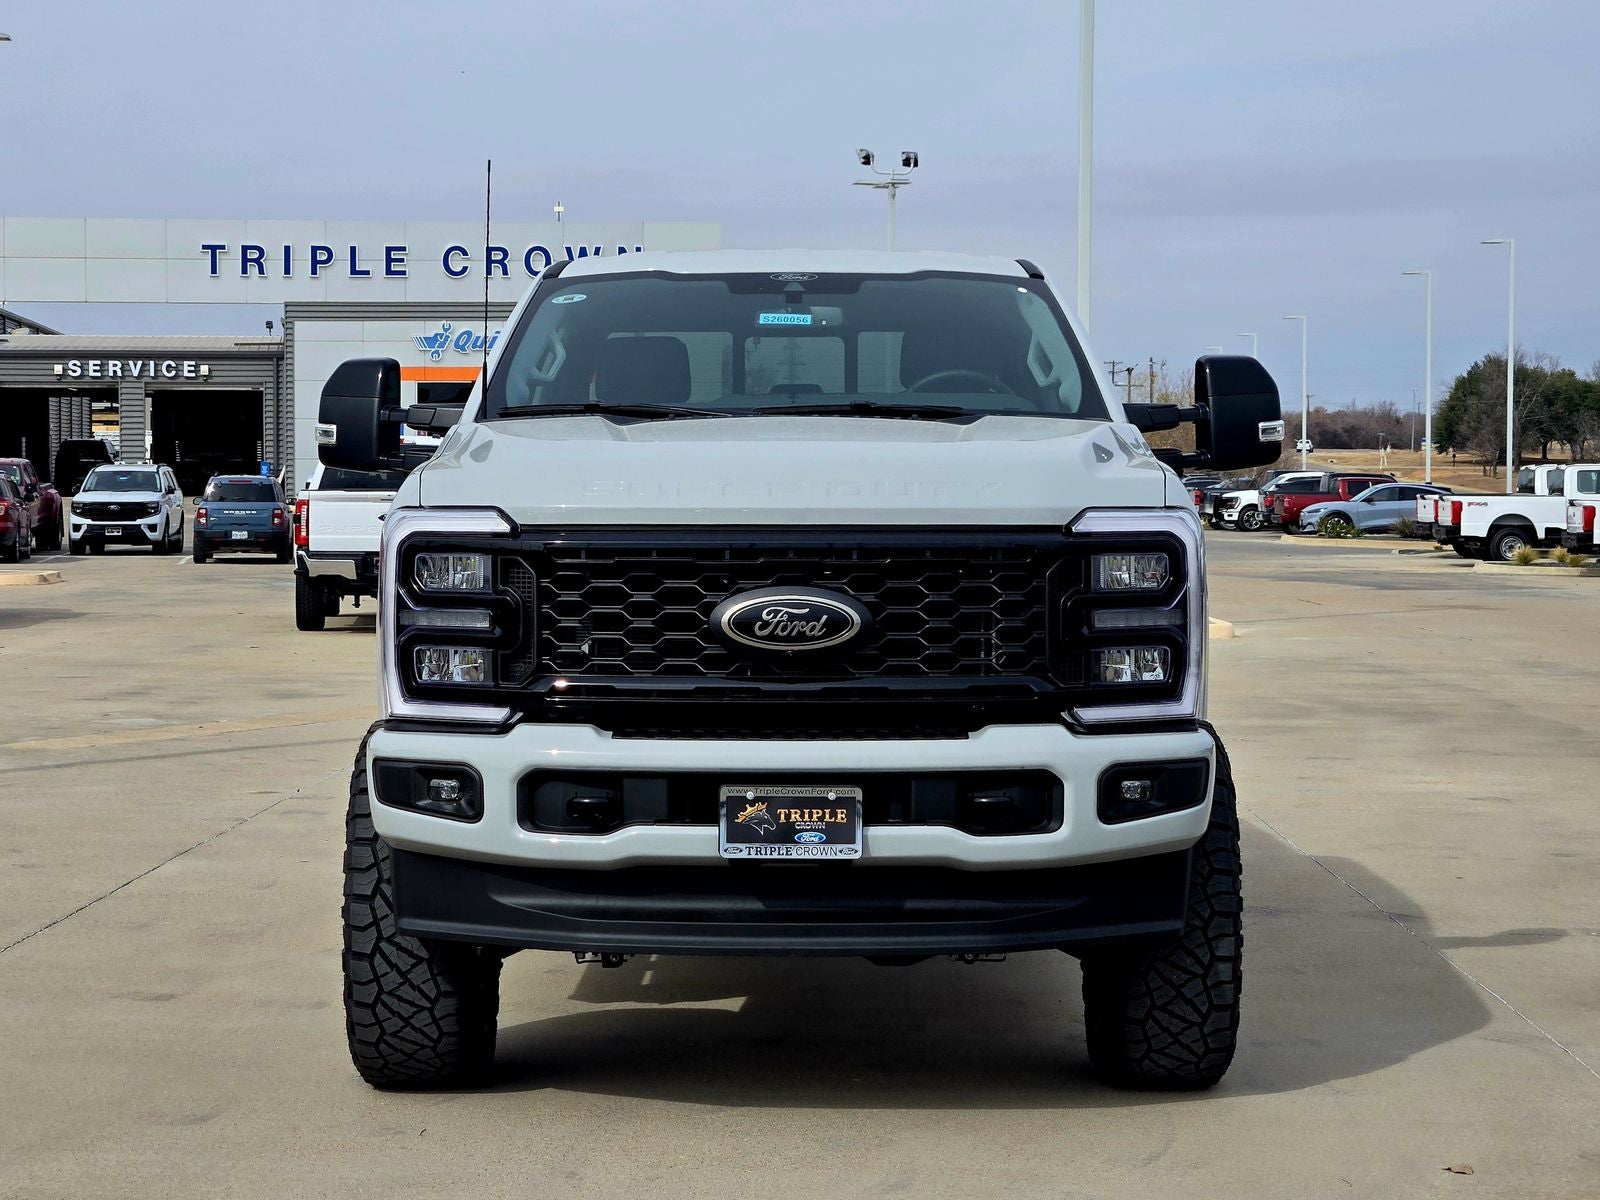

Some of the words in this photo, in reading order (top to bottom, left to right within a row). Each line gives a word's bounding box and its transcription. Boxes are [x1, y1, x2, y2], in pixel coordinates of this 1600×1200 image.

[201, 243, 409, 278] TRIPLE
[442, 243, 643, 279] CRO
[762, 315, 809, 323] S260056
[453, 329, 501, 353] Qui
[67, 359, 196, 377] SERVICE
[754, 606, 828, 637] Ford
[727, 787, 856, 795] wwwTripleCrownFordcom
[776, 808, 847, 823] TRIPLE
[795, 821, 826, 829] CROWN
[800, 833, 820, 842] Ford
[745, 846, 793, 856] TRIPLE
[795, 846, 838, 856] CROWN
